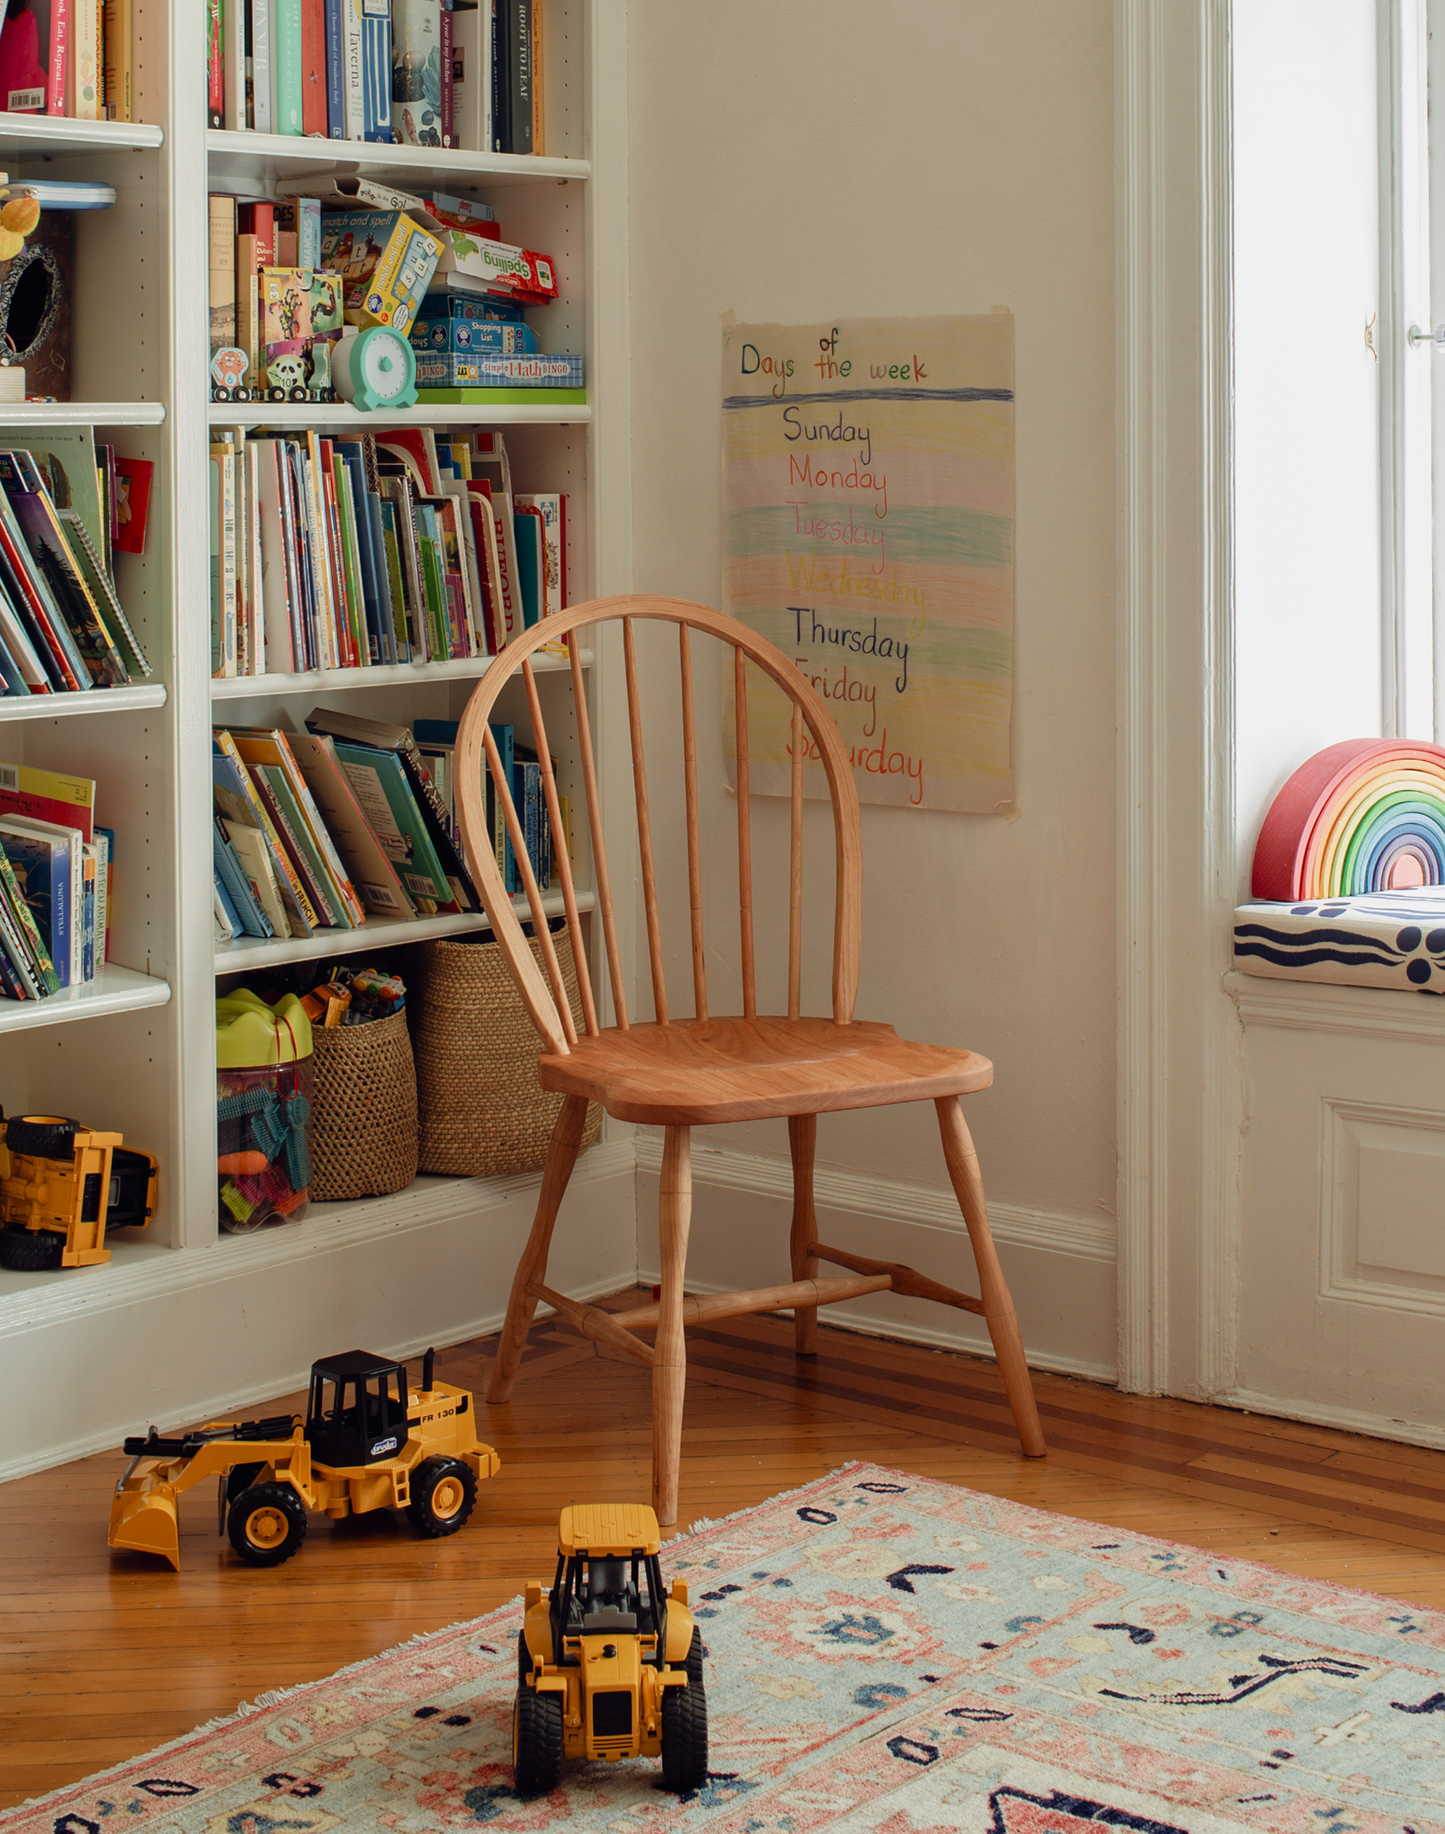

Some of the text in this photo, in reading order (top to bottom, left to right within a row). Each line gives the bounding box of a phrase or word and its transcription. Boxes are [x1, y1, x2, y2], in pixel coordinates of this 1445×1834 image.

[56, 21, 66, 42] Eat,
[442, 22, 450, 38] year
[444, 38, 450, 47] in
[55, 45, 65, 82] Repeat
[350, 30, 360, 88] Taverna
[442, 47, 449, 58] my
[519, 4, 528, 101] ROOT TO LEAF
[390, 196, 407, 209] Go!
[321, 213, 394, 229] match and spell
[324, 240, 332, 250] a
[356, 246, 362, 258] t
[376, 224, 408, 292] match and spell
[483, 250, 530, 279] Spelling
[471, 321, 502, 334] Shopping
[480, 333, 494, 342] List
[422, 365, 445, 376] BINGO
[484, 361, 568, 377] Simple Math BINGO
[741, 327, 928, 398] Days of the week
[227, 374, 234, 384] 6
[281, 378, 292, 388] 10
[783, 406, 872, 466] Sunday
[790, 454, 888, 520] Monday
[786, 501, 886, 575] Tuesday
[224, 518, 234, 607] HOW SHIPS WORK
[786, 549, 926, 640] Wednesday
[786, 607, 908, 694] Thursday
[786, 718, 924, 806] Surday
[298, 851, 308, 864] you
[304, 862, 314, 874] Can
[268, 875, 284, 906] Oh Dear!
[271, 840, 316, 923] DICTIONARY in FRENCH
[96, 863, 106, 952] FIFTEEN ANIMALS!
[422, 1408, 454, 1423] FR 130
